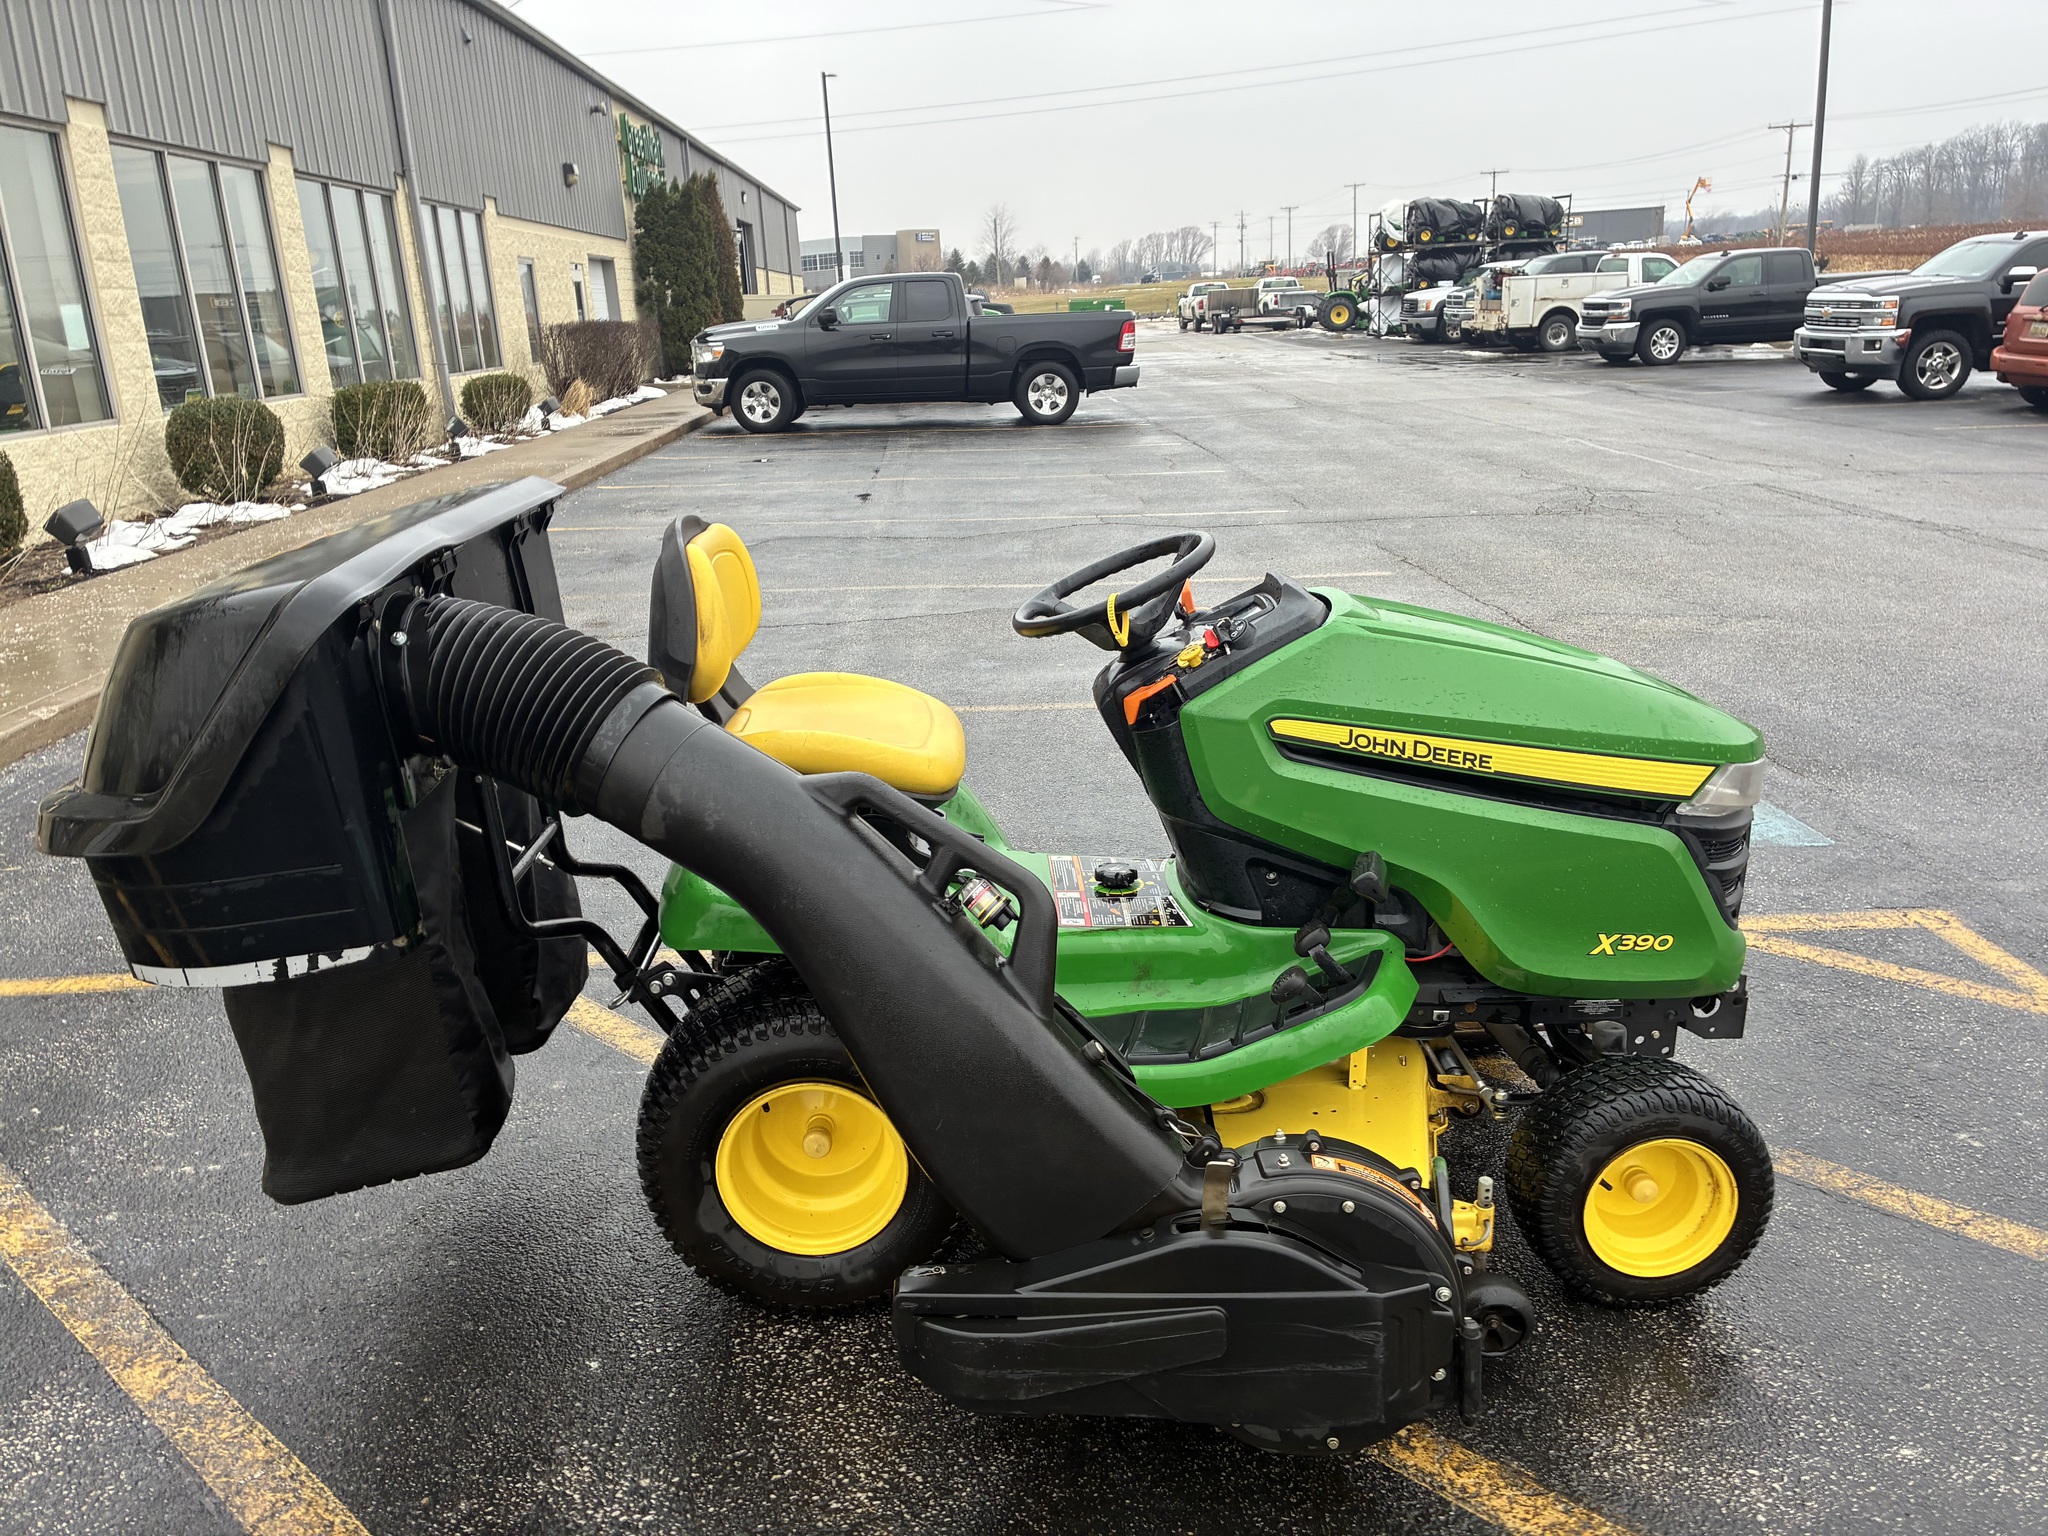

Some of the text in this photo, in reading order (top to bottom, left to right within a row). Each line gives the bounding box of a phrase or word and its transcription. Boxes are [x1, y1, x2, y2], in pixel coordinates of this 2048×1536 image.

[620, 113, 664, 168] GreenMark
[1339, 729, 1493, 770] JOHN DEERE
[1586, 933, 1675, 956] X390
